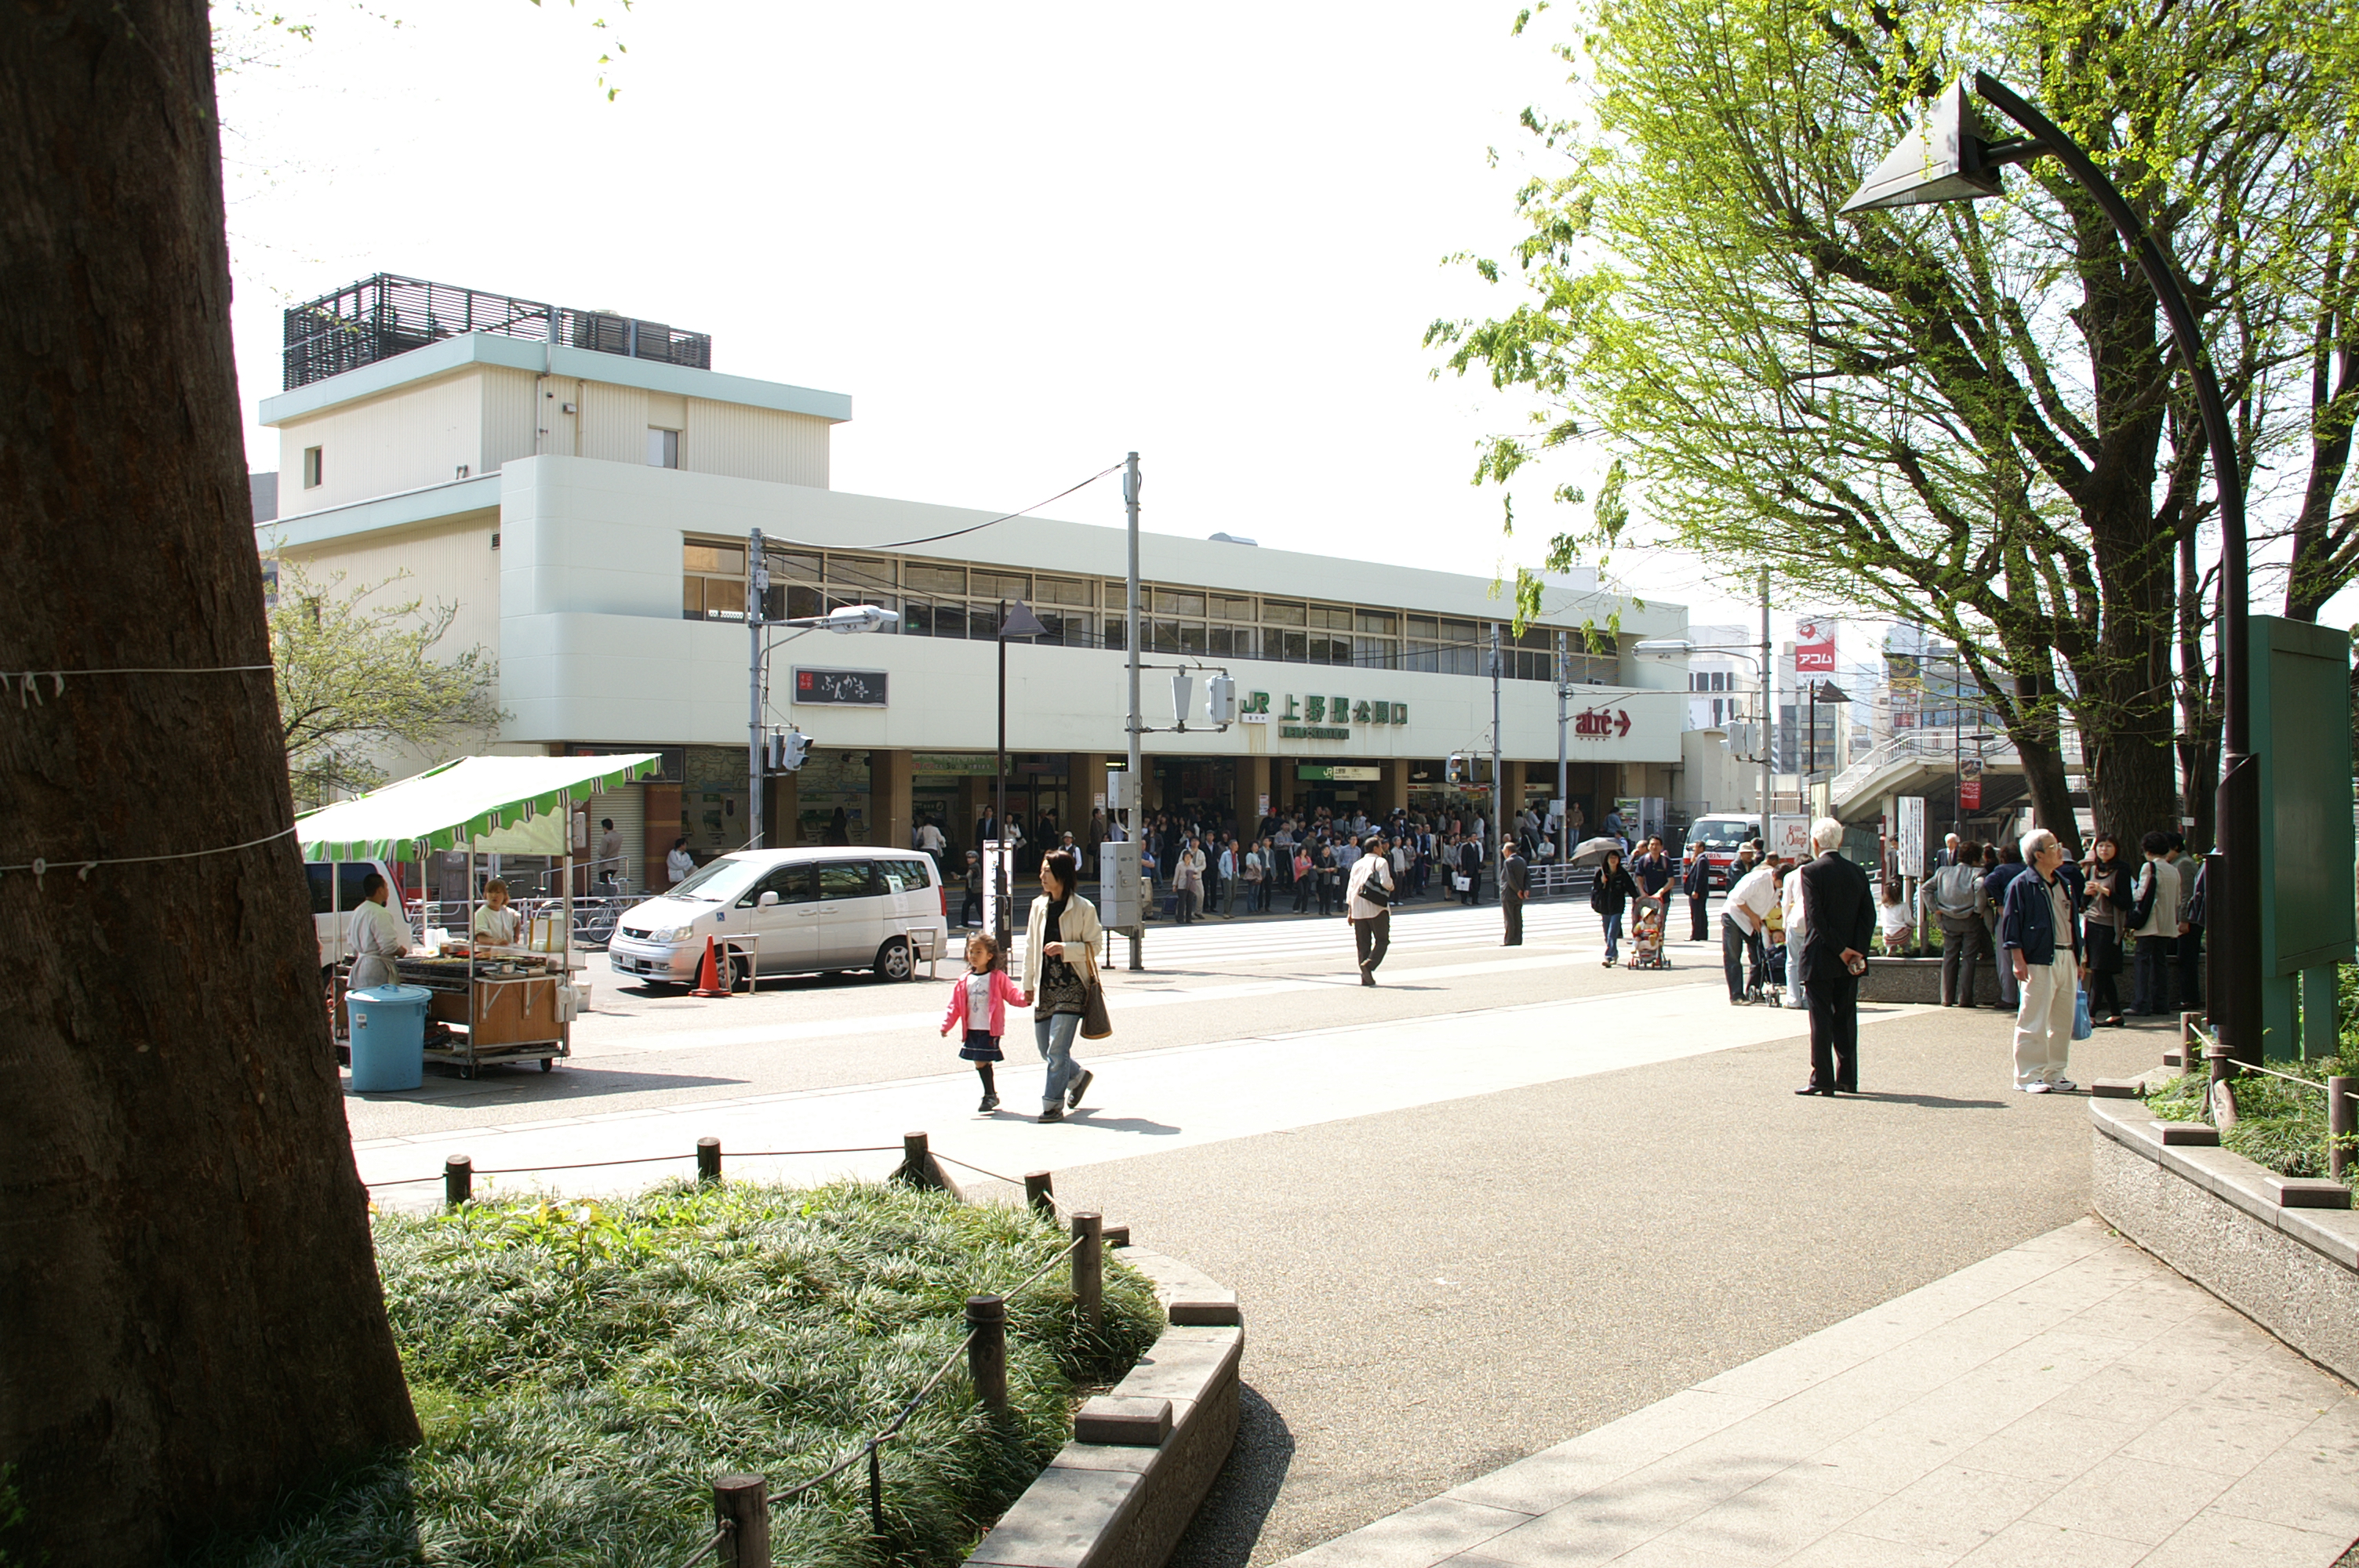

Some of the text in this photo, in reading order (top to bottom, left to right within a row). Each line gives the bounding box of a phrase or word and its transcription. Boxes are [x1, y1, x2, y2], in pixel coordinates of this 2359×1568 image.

[1799, 653, 1833, 664] アコム
[821, 675, 869, 699] ぶんか亭
[1239, 691, 1408, 724] JR 上野駅公園口
[1308, 727, 1350, 739] STATION
[1323, 768, 1333, 776] JR
